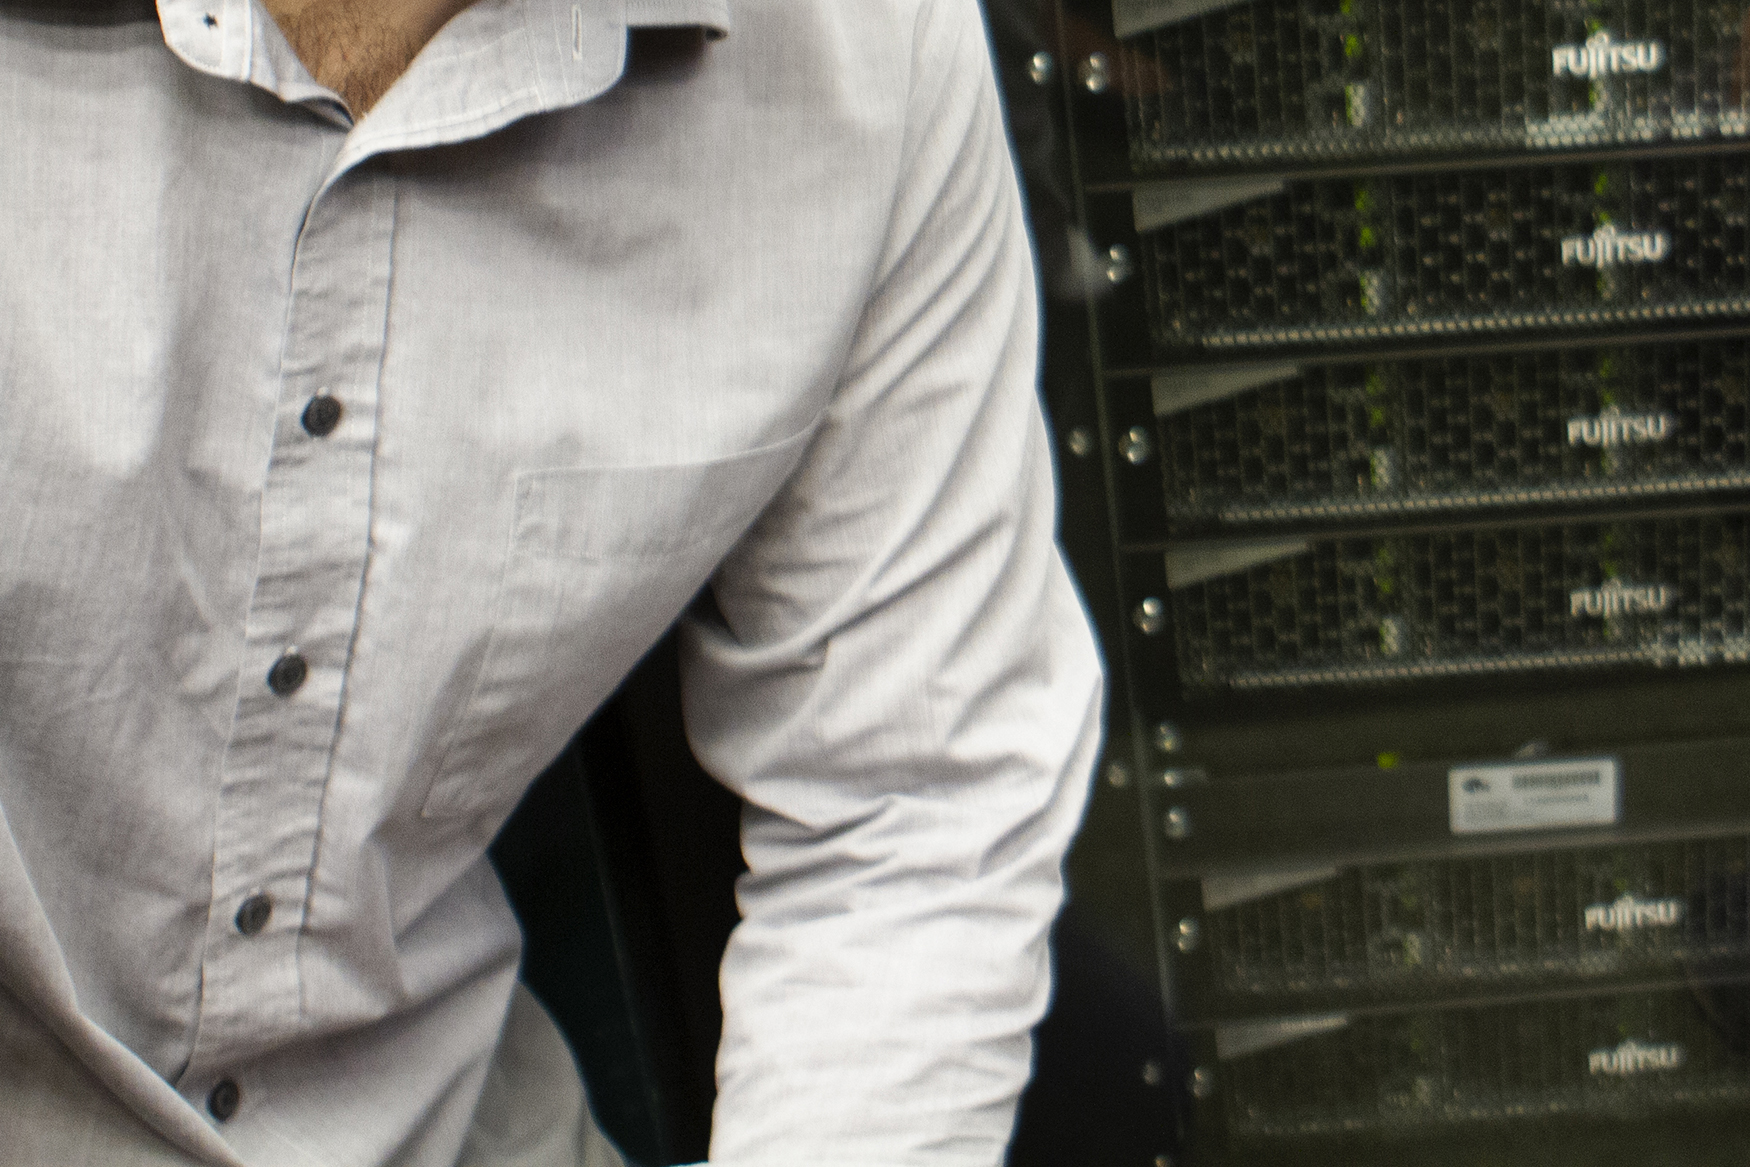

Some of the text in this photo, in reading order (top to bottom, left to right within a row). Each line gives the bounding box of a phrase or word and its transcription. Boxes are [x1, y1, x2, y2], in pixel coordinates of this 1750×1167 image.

[1552, 30, 1658, 80] FUJITSU
[1561, 223, 1664, 270] FUJITSU
[1567, 405, 1666, 449] FUJITSU
[1570, 577, 1666, 619] FUJITSU
[1585, 894, 1679, 933] FUJITSU
[1589, 1040, 1679, 1076] FUJITSU
